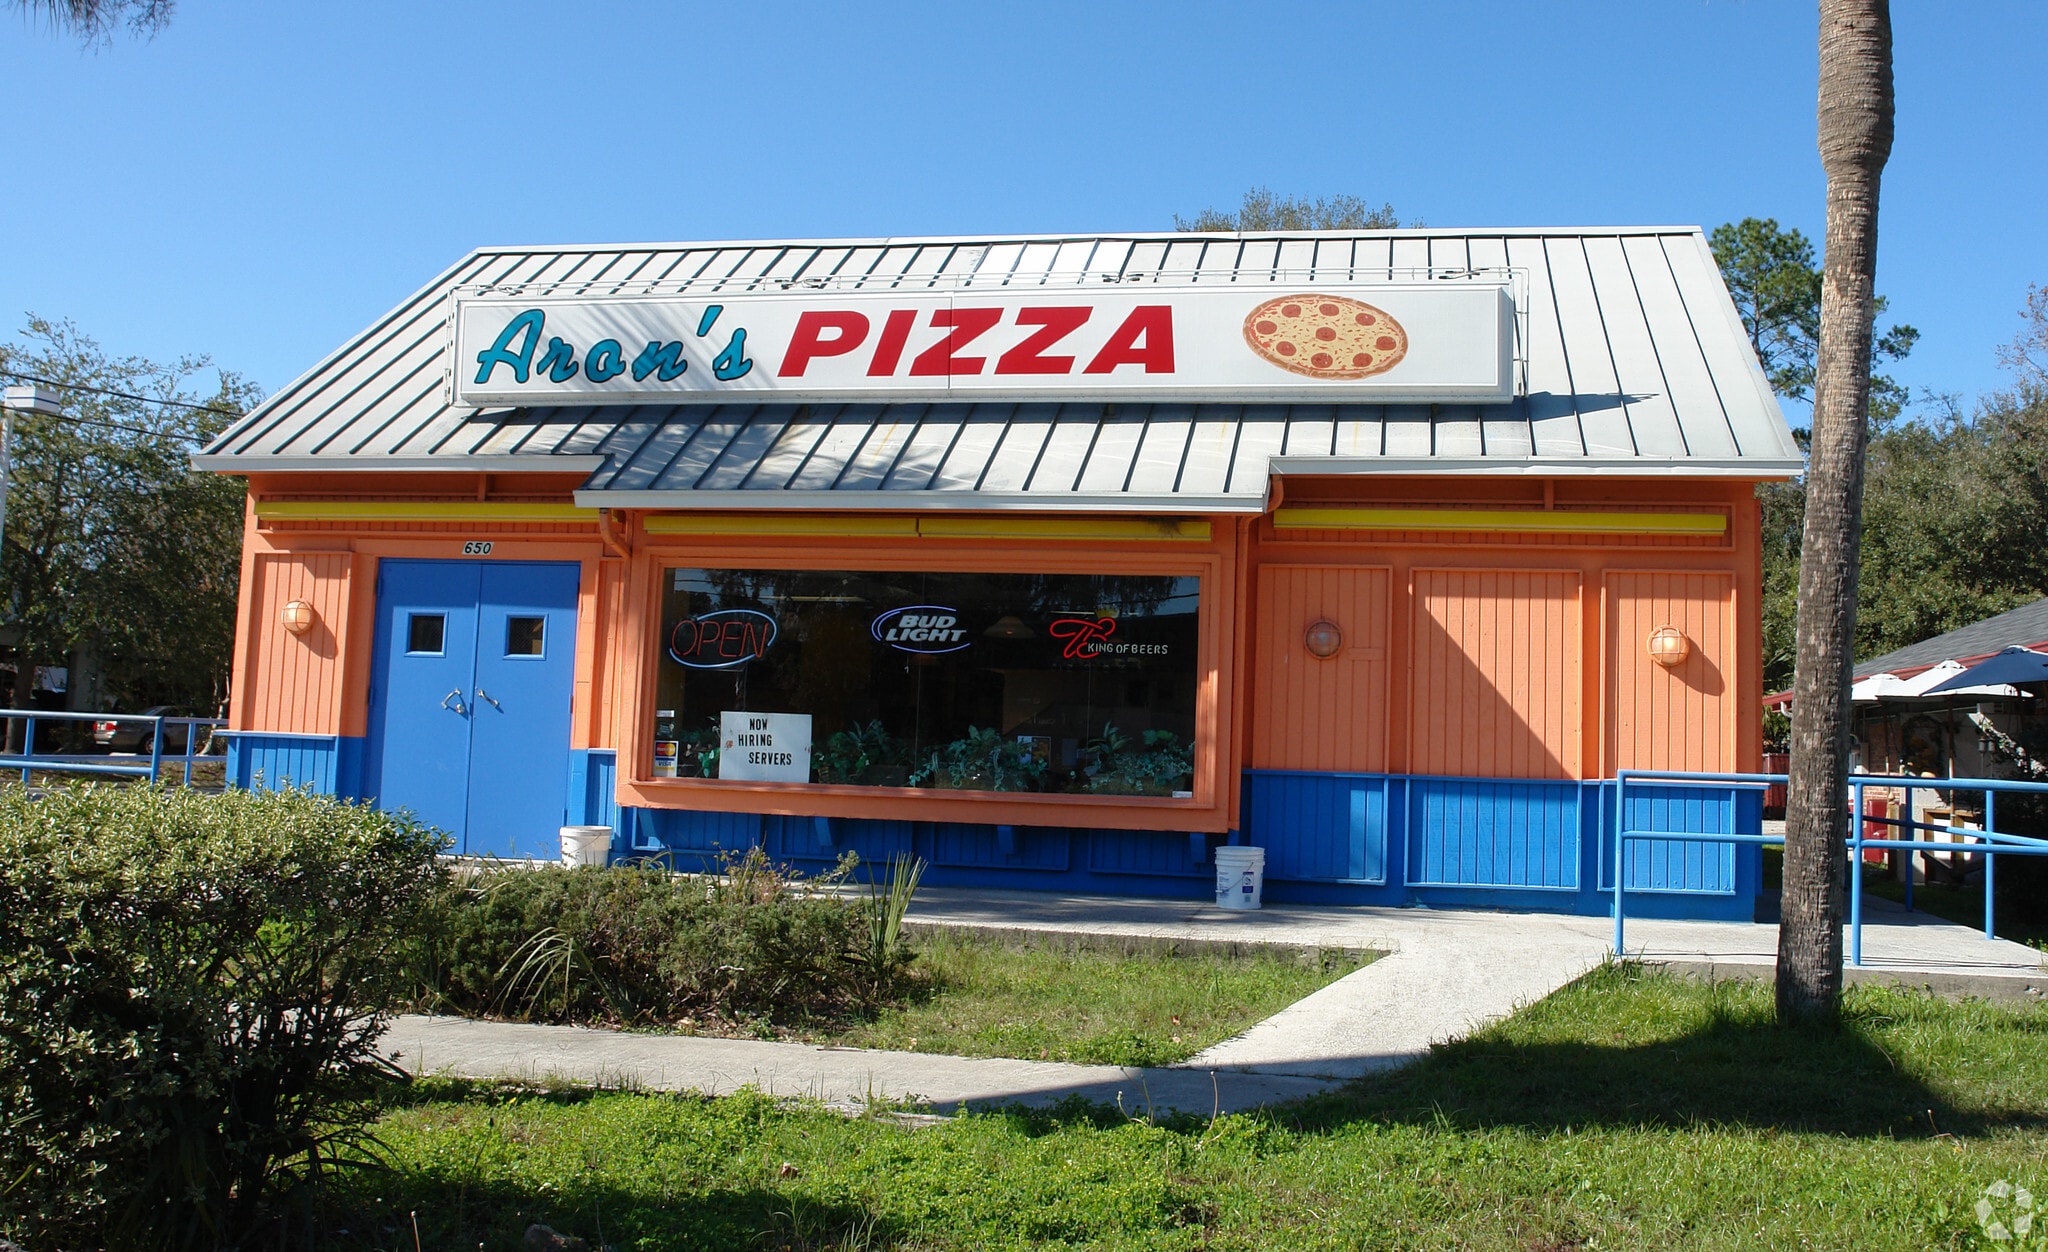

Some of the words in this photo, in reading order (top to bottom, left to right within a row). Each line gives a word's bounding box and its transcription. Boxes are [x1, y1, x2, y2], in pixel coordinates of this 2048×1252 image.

[474, 304, 754, 385] Aron's
[776, 304, 1176, 378] PIZZA
[464, 541, 493, 555] 650
[898, 614, 957, 629] BUD
[671, 619, 769, 659] OPEN
[885, 627, 968, 642] LIGHT
[1087, 642, 1114, 653] KING
[1115, 643, 1131, 654] OF
[1131, 643, 1169, 655] BEERS
[749, 717, 768, 731] NOW
[738, 733, 773, 747] HIRING
[748, 751, 793, 766] SERVERS
